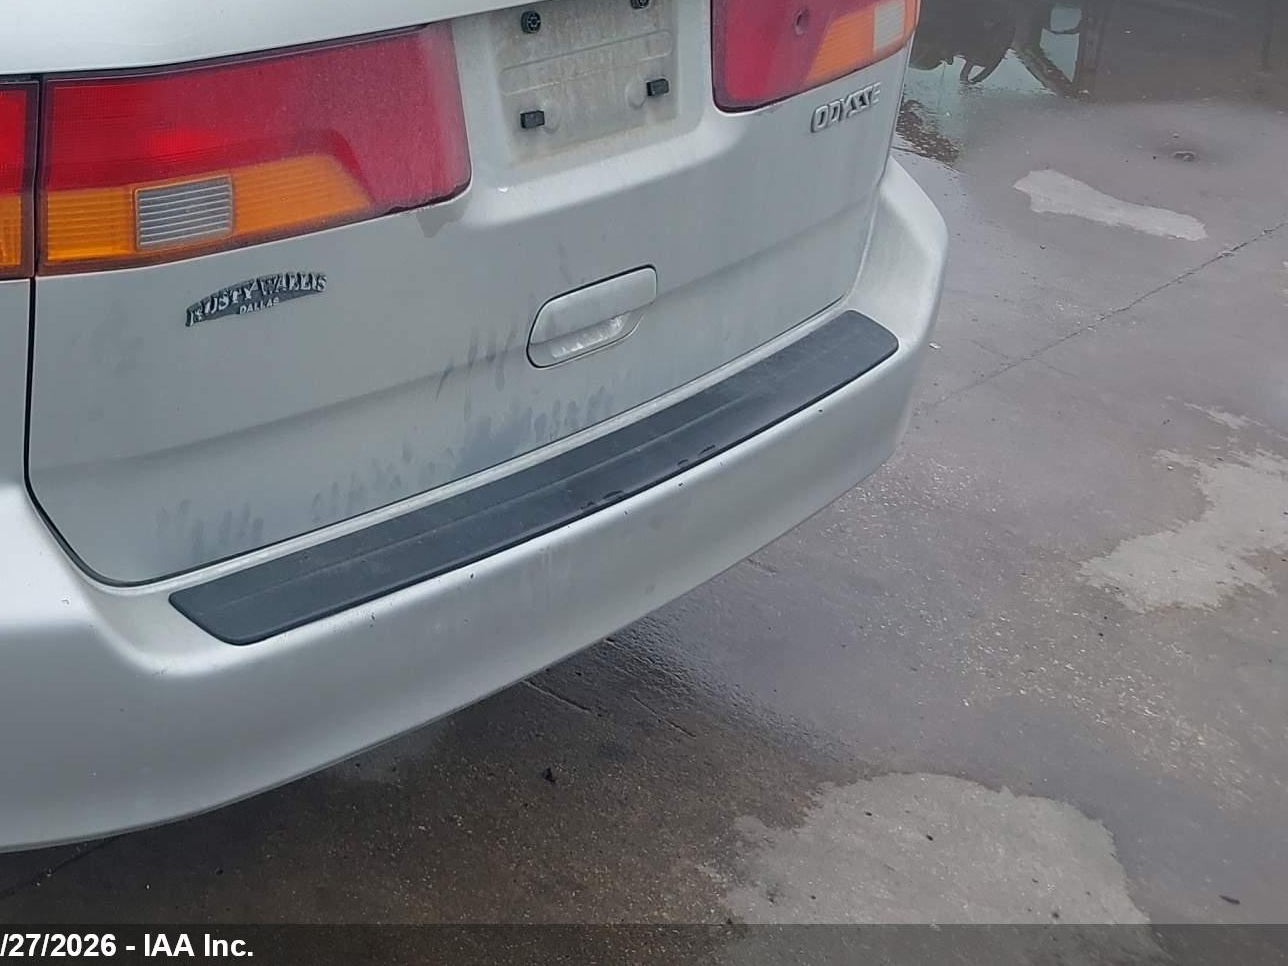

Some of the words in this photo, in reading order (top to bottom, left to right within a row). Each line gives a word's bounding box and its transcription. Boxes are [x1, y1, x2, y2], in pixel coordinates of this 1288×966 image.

[186, 280, 259, 326] RUSTY
[258, 273, 328, 297] WALLIS
[239, 297, 280, 315] DALLAS
